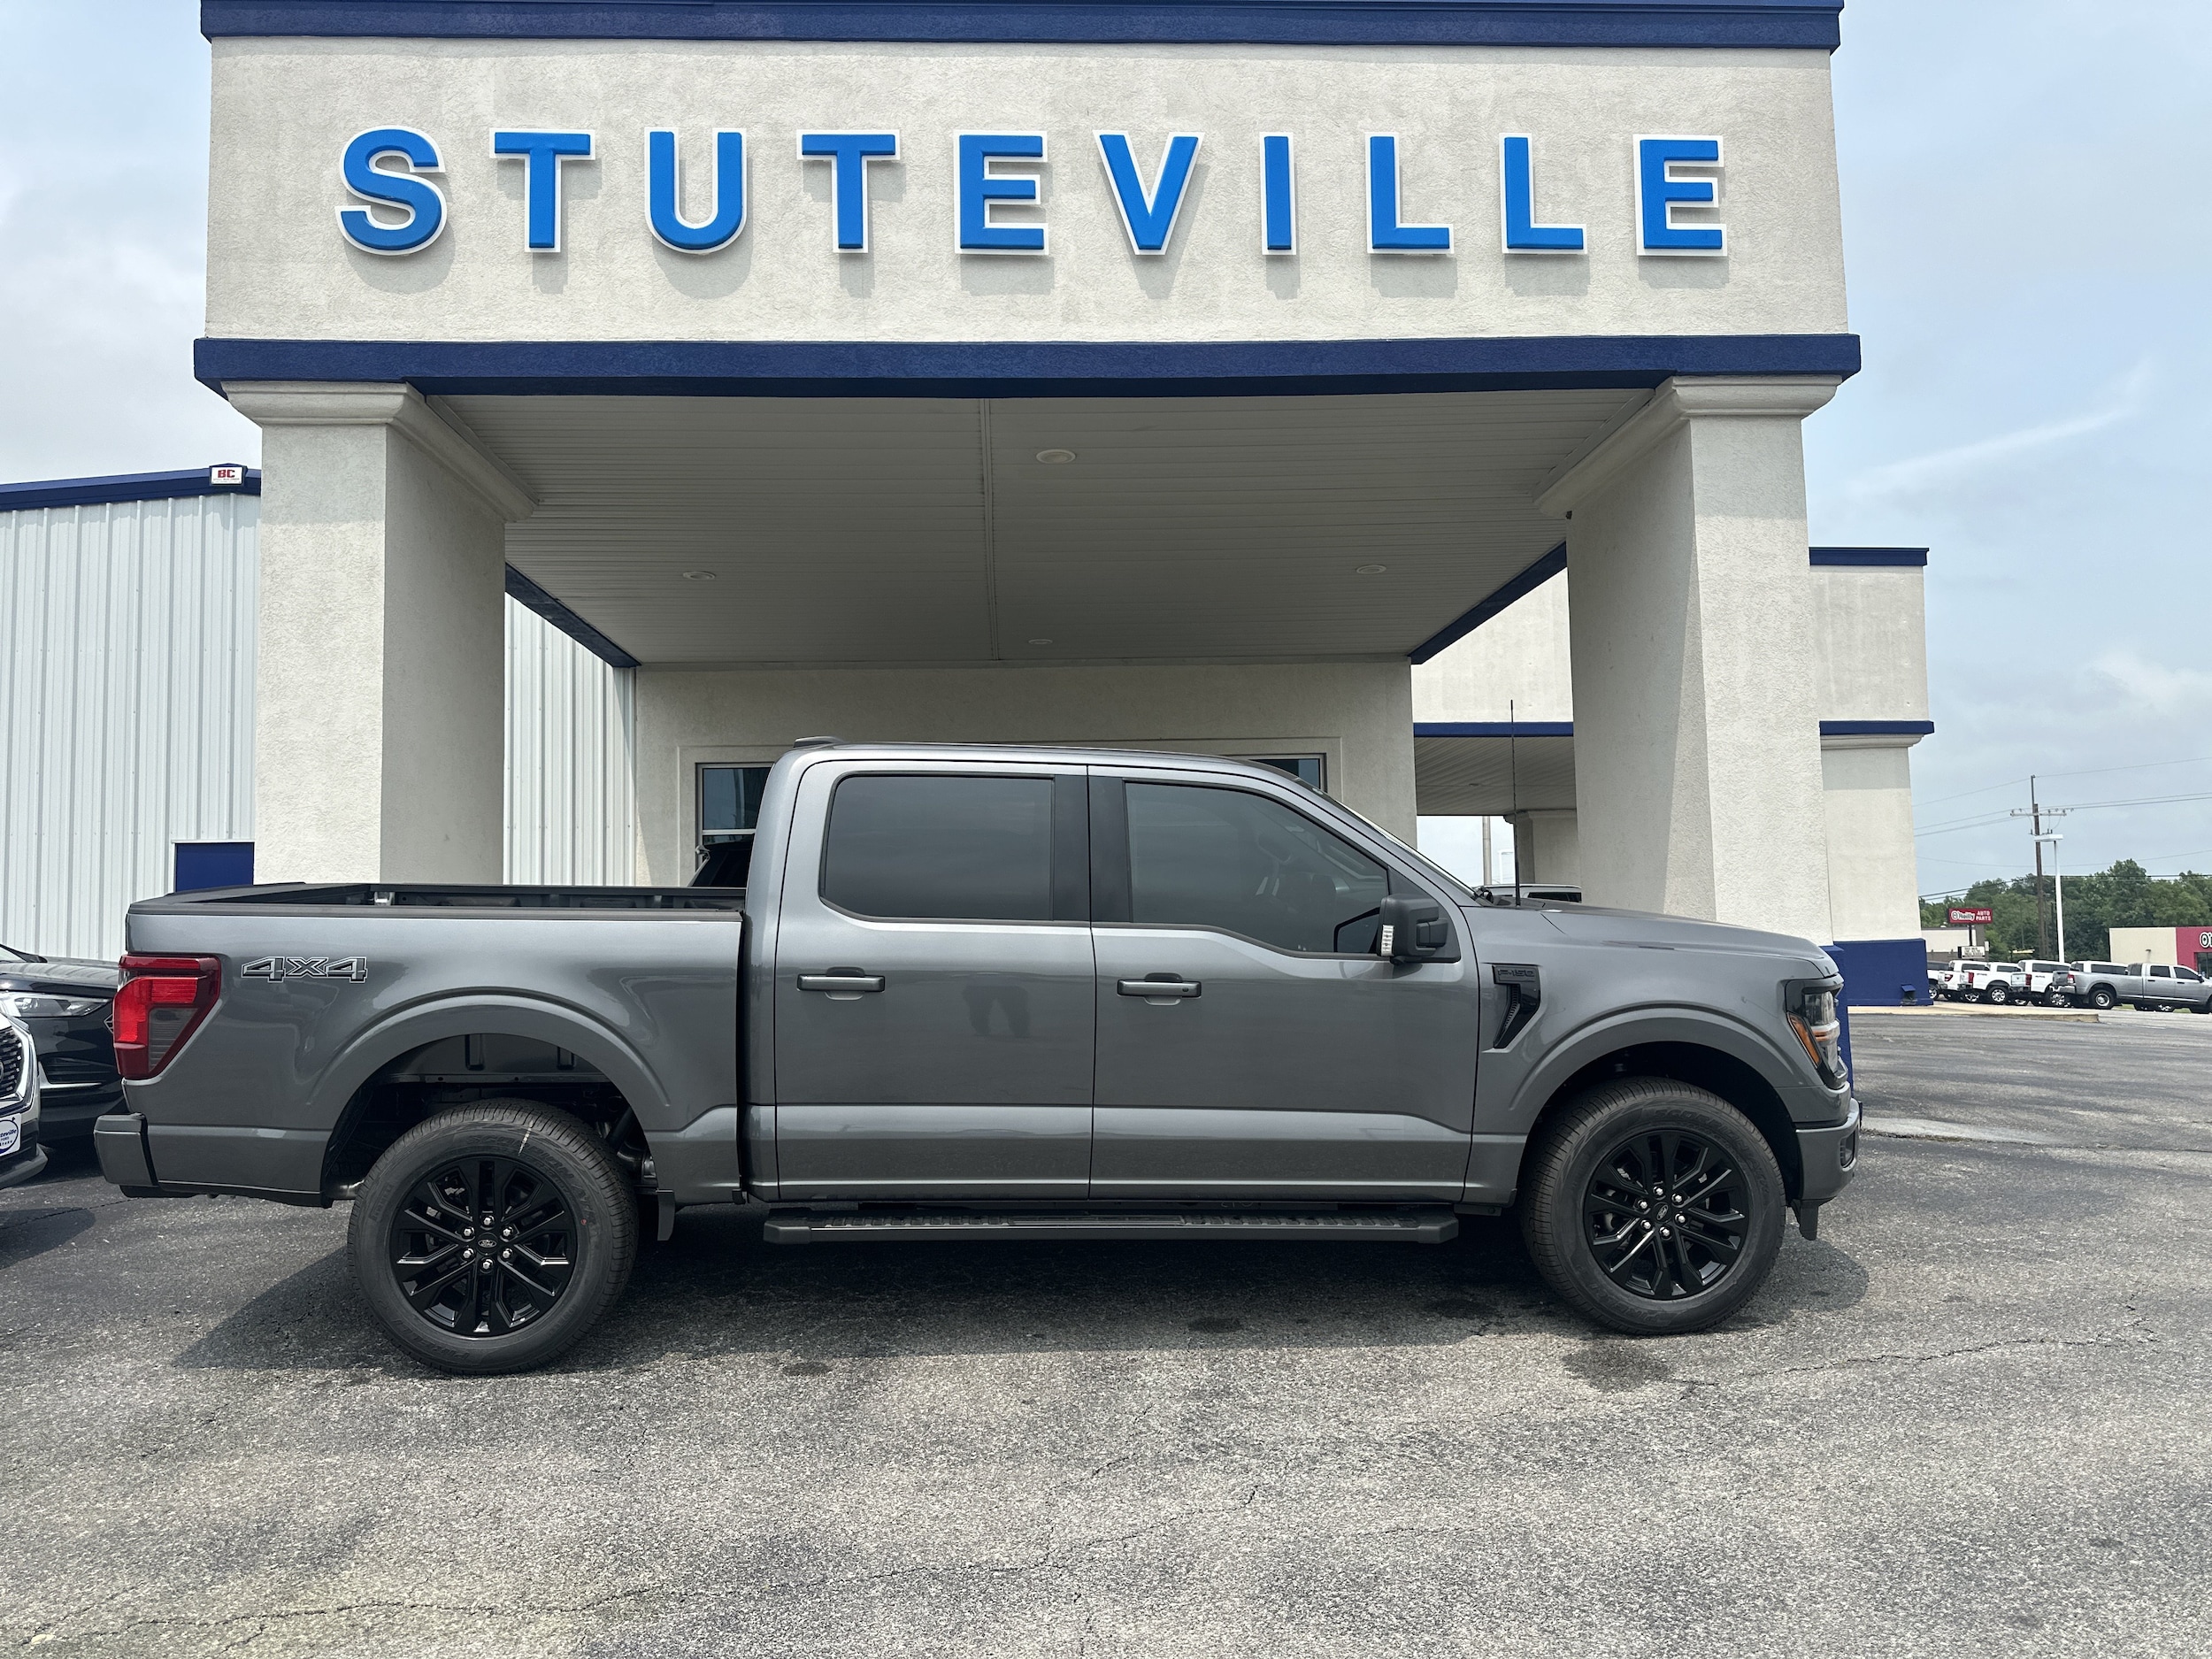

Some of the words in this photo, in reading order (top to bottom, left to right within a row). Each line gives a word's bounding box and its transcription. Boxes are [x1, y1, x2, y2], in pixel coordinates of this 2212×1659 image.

[337, 127, 1727, 258] STUTEVILLE
[218, 469, 235, 478] BC
[1951, 910, 1975, 921] O'Reilly
[2200, 932, 2212, 948] O'
